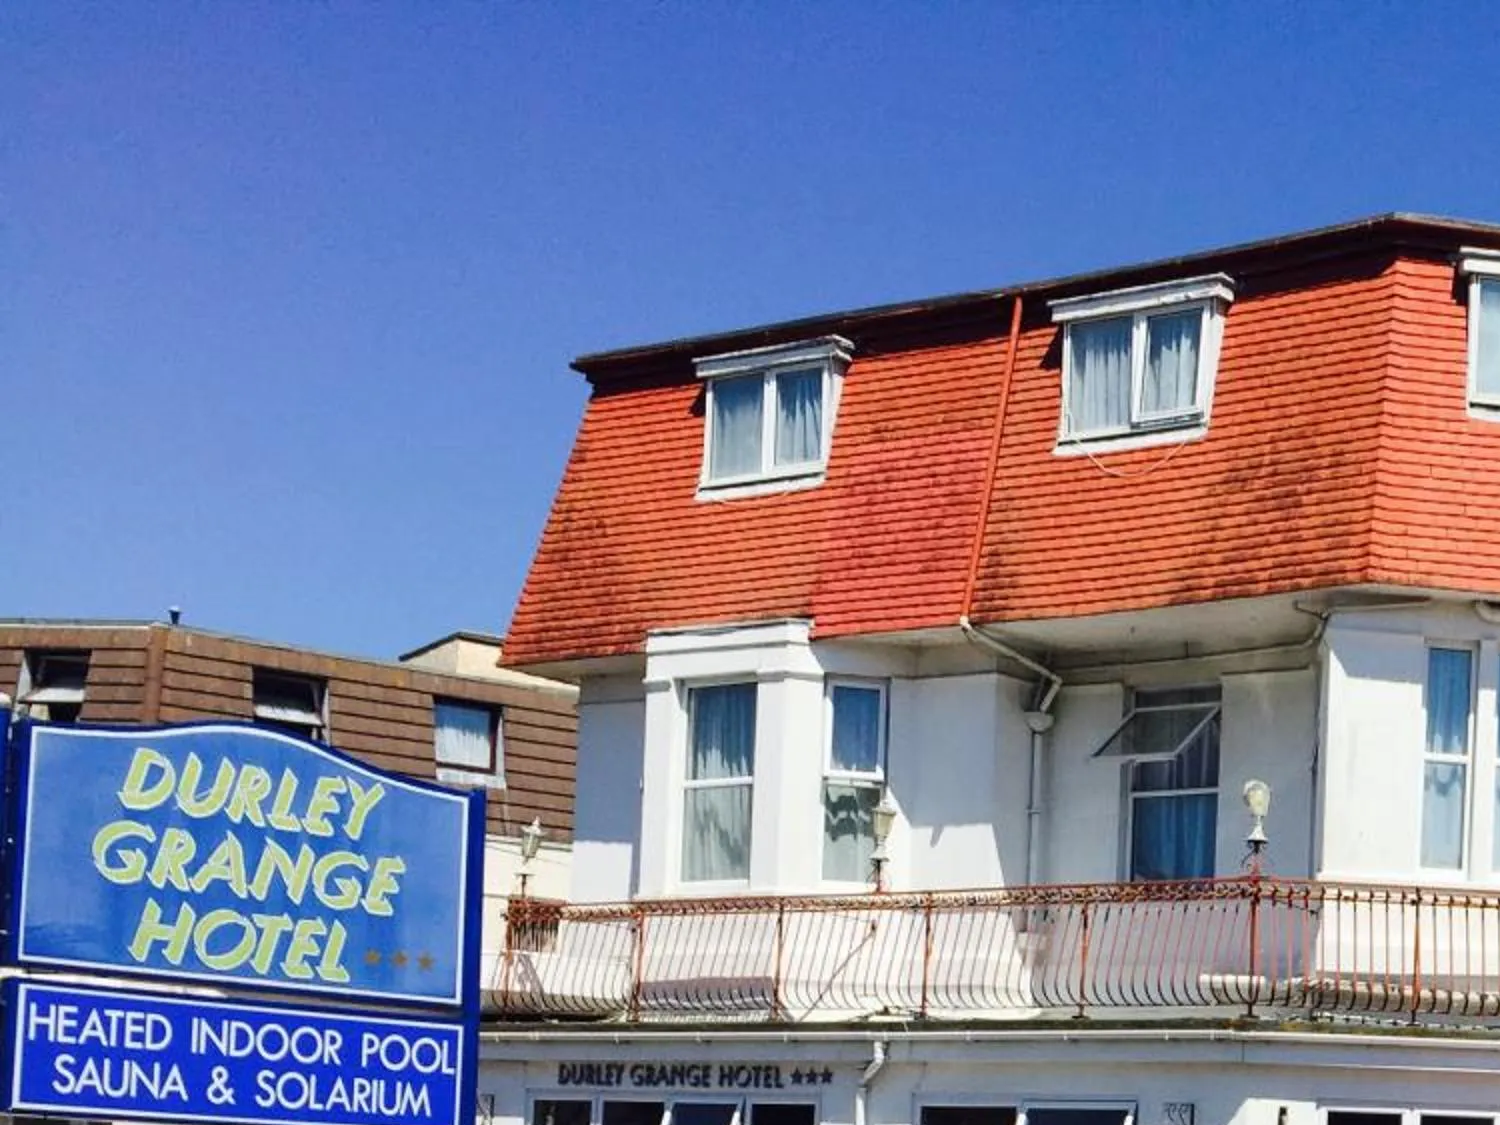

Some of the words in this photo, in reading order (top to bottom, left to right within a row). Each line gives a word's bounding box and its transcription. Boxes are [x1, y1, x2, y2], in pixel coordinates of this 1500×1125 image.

[118, 747, 385, 840] DURLEY
[92, 819, 407, 916] GRANGE
[128, 898, 350, 982] HOTEL
[28, 1002, 172, 1050] HEATED
[191, 1017, 343, 1066] INDOOR
[361, 1033, 456, 1075] POOL
[558, 1063, 624, 1087] DURLEY
[629, 1063, 711, 1088] GRANGE
[719, 1065, 785, 1089] HOTEL
[52, 1054, 188, 1102] SAUNA
[206, 1066, 235, 1104] &
[256, 1071, 431, 1117] SOLARIUM
